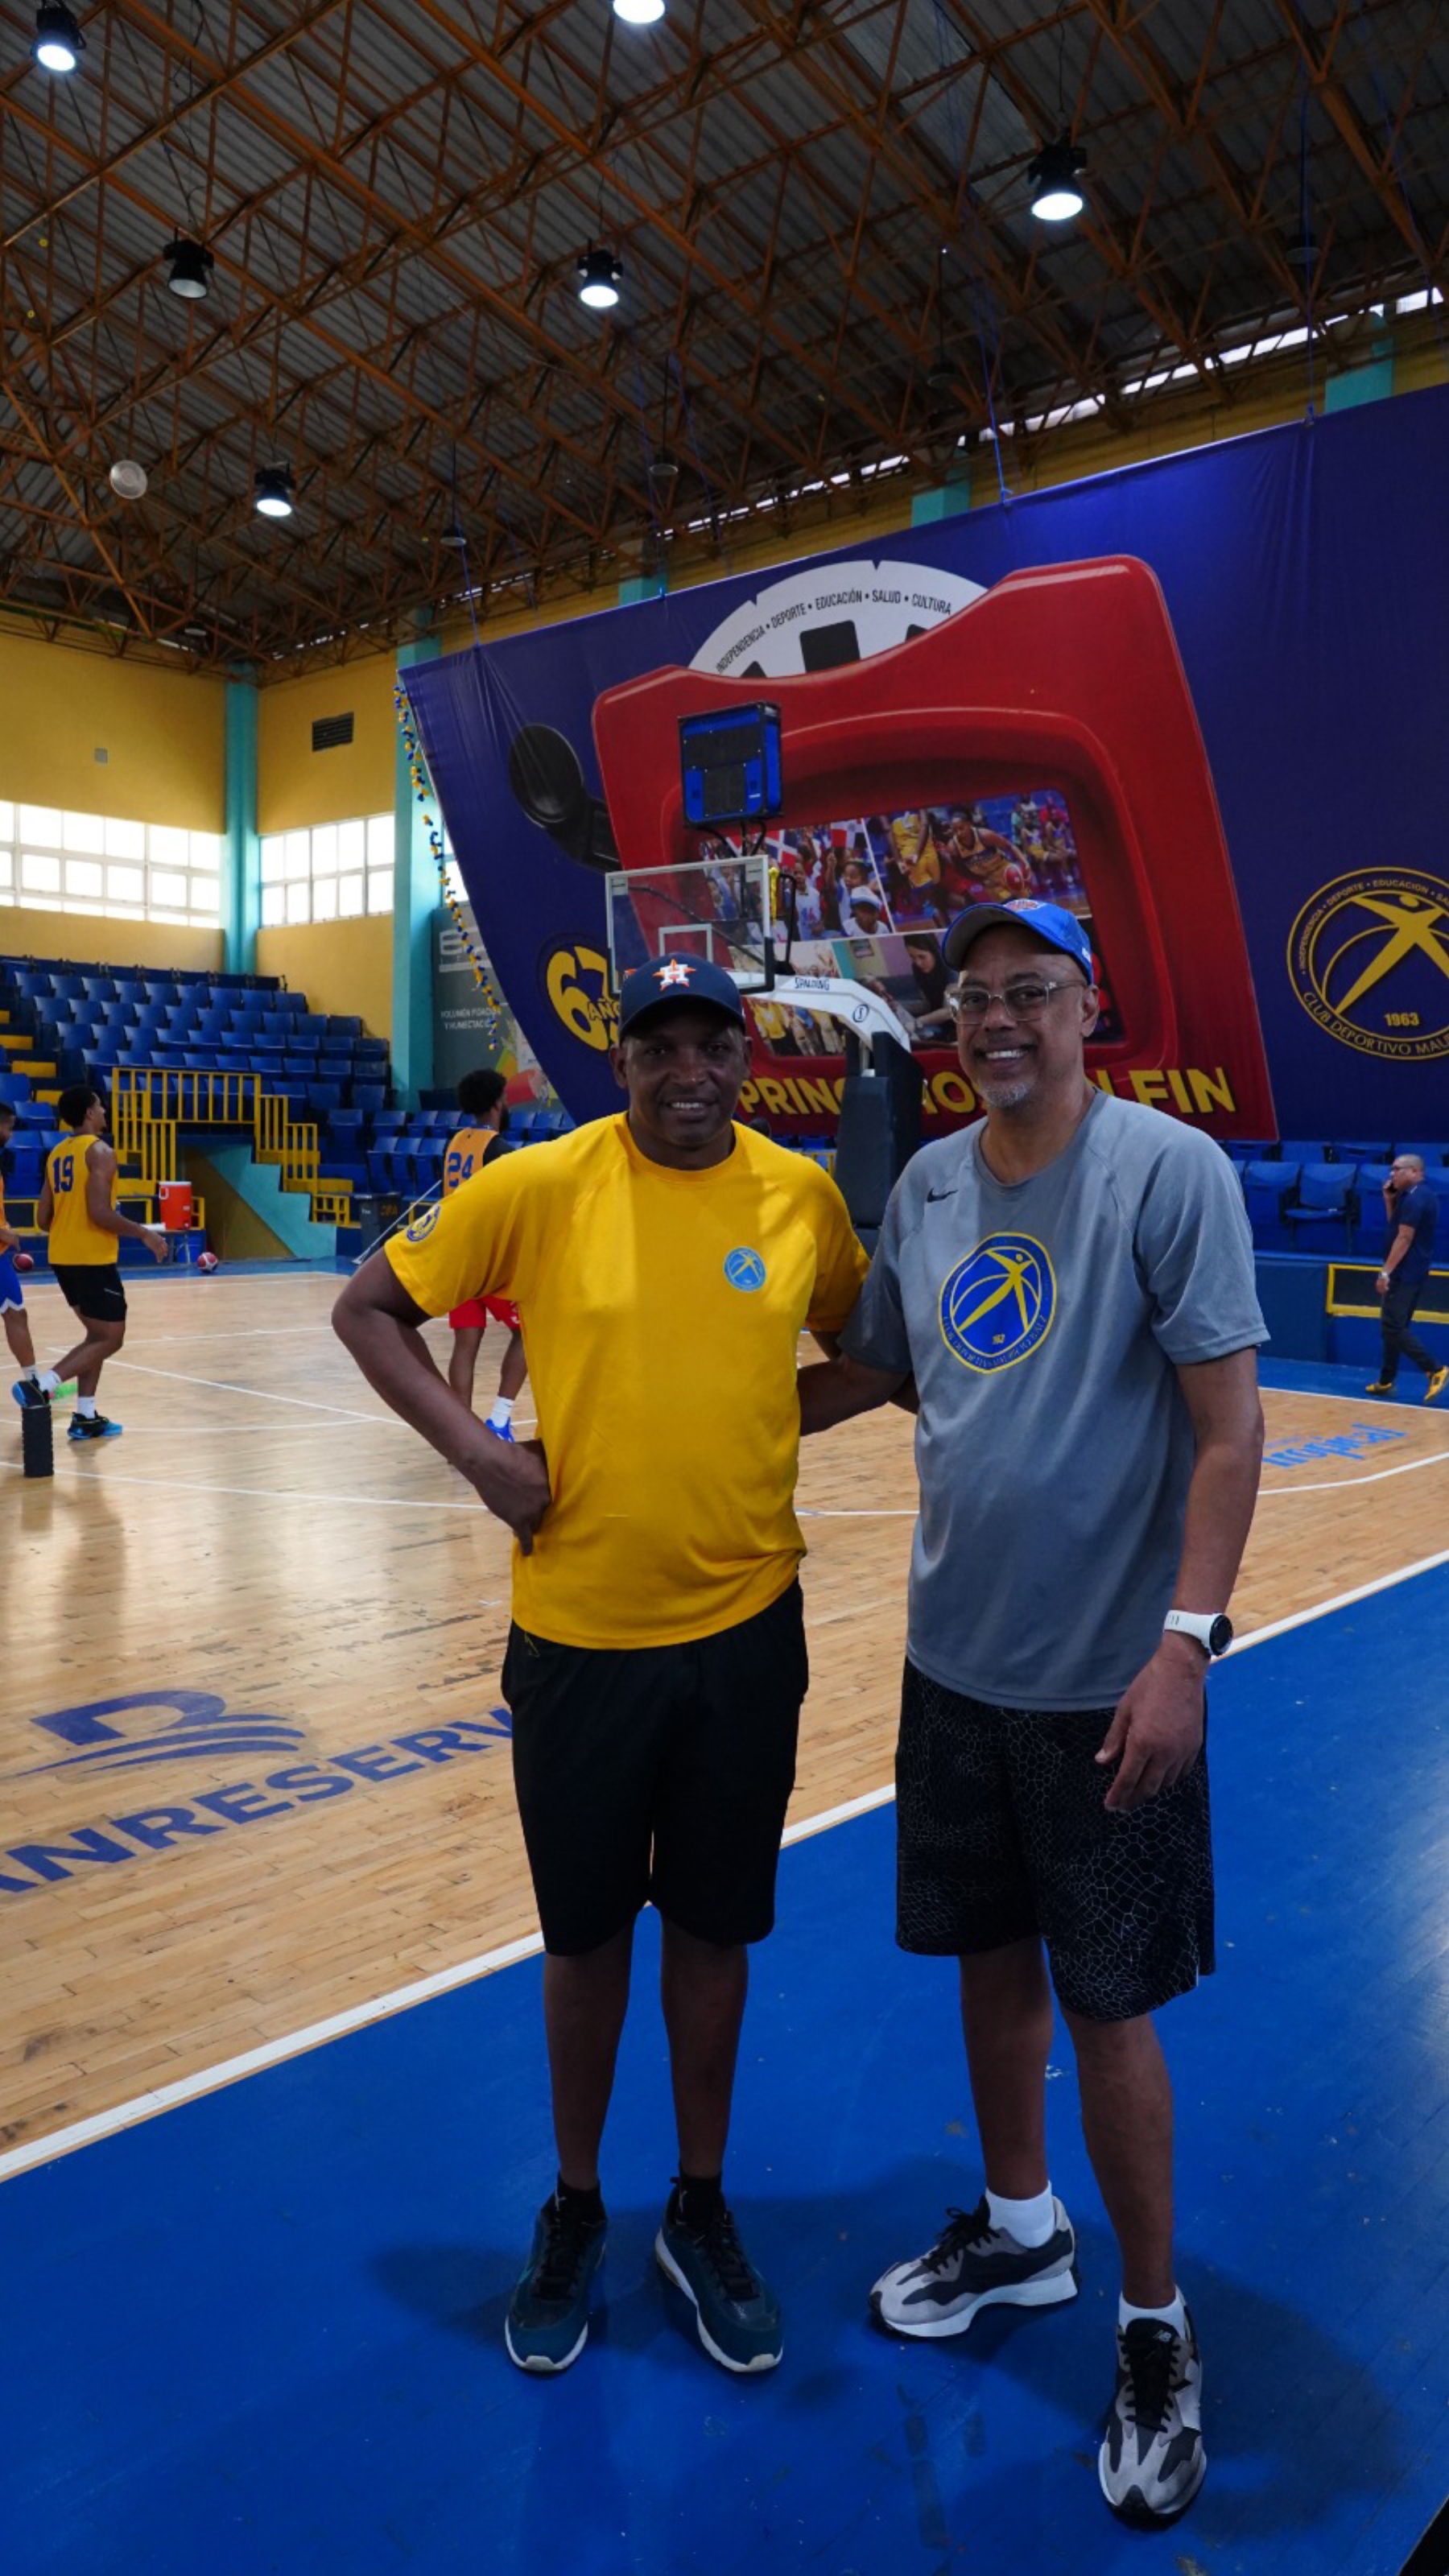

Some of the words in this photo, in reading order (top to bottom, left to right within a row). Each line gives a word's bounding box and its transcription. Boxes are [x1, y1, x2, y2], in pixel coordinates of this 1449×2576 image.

[715, 625, 766, 674] INDEPENDENCIA
[770, 602, 807, 629] DEPORTE
[815, 588, 862, 610] EDUCACIÓN
[872, 588, 902, 605] SALUD
[911, 593, 952, 615] CULTURA
[1302, 991, 1332, 1023] CLUB
[1330, 1020, 1411, 1055] DEPORTIVO
[1384, 1011, 1421, 1026] 1963
[1129, 1067, 1236, 1113] FIN
